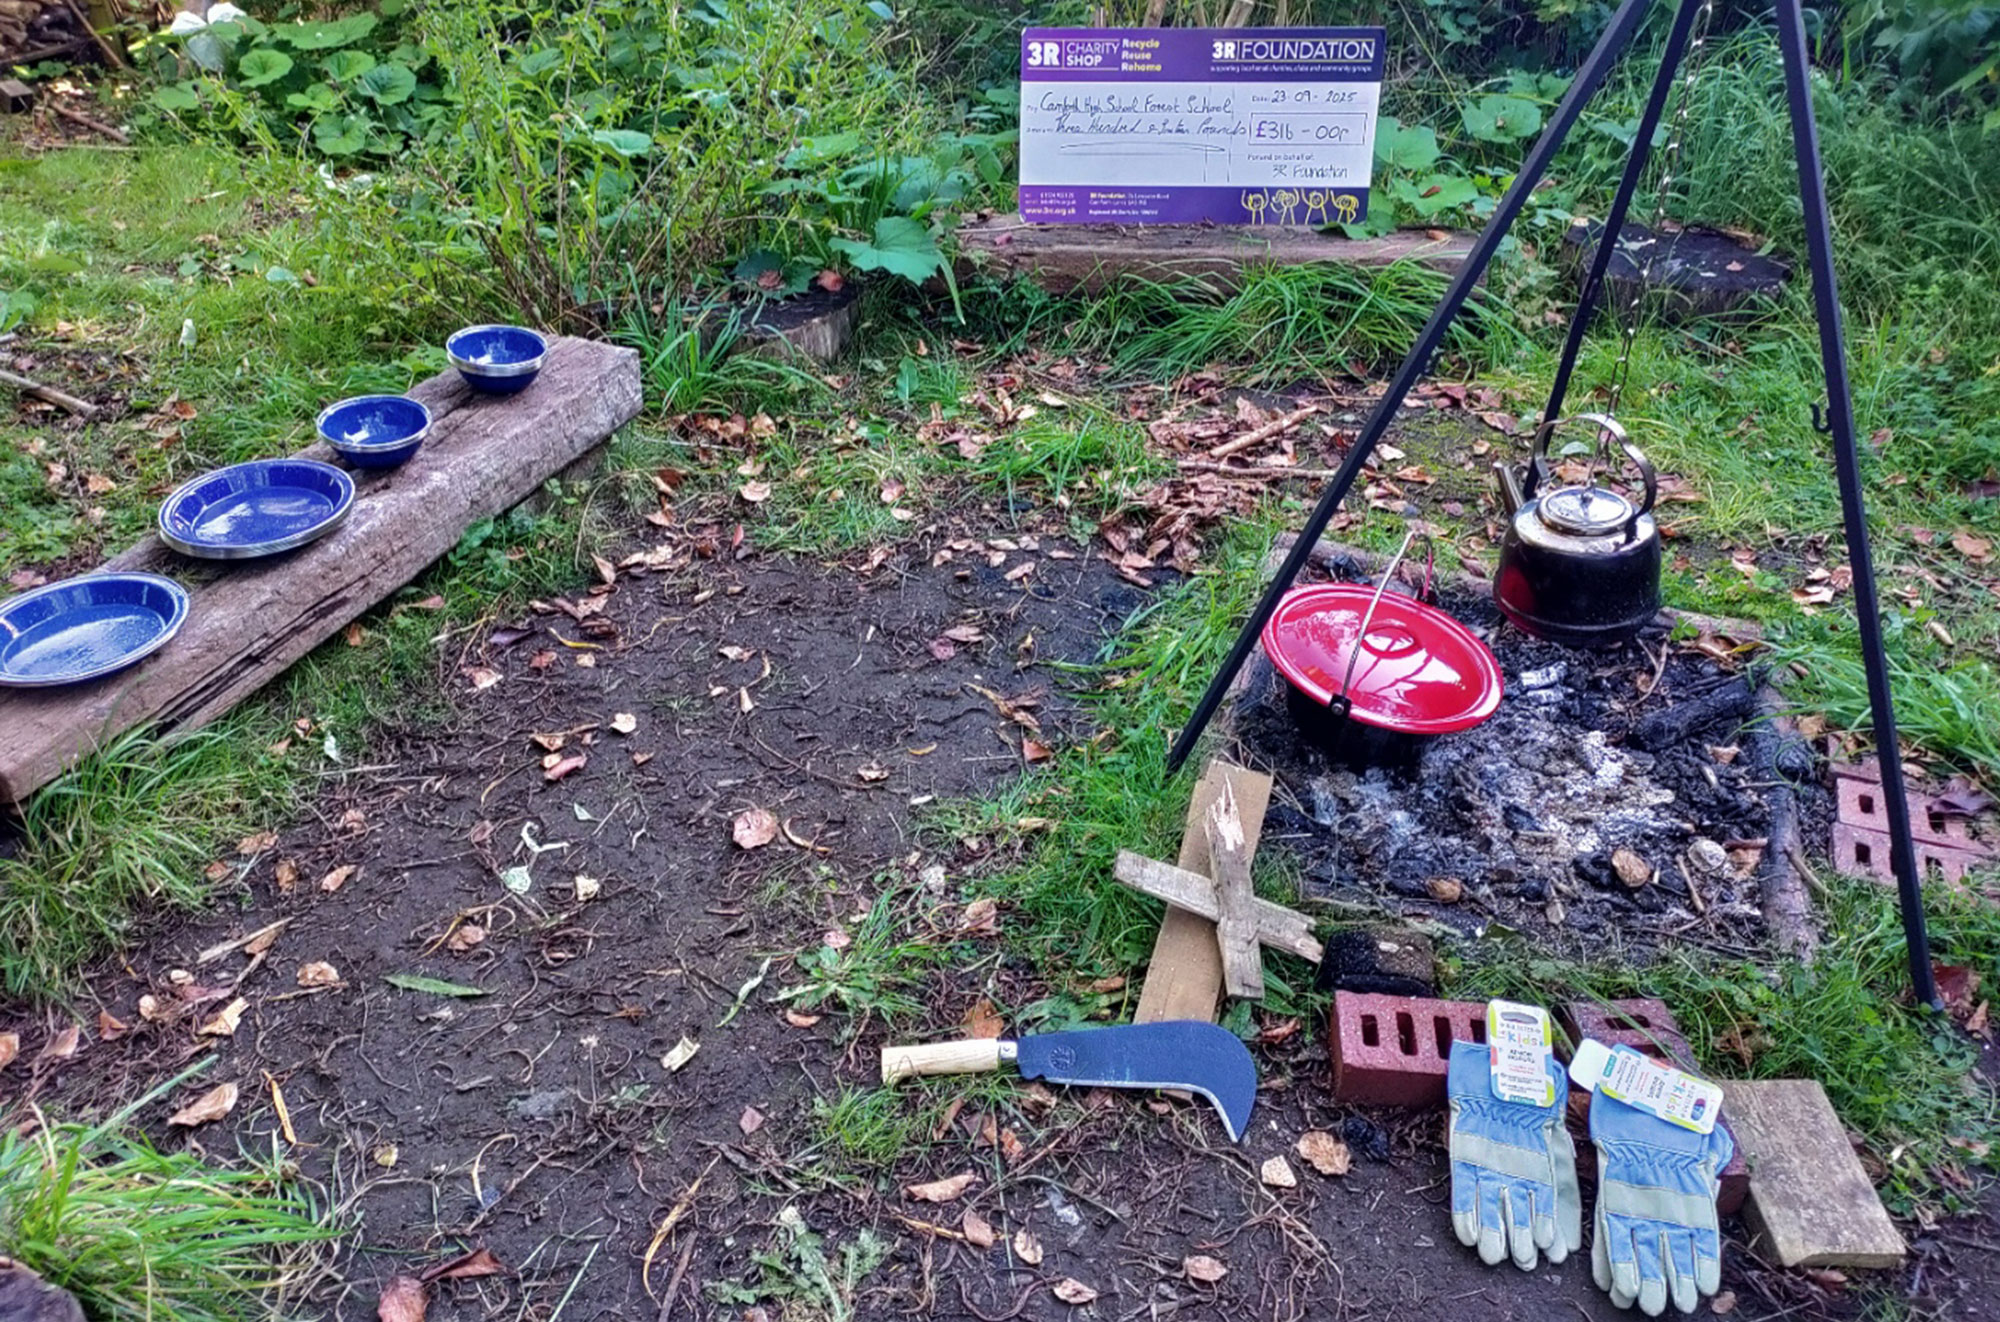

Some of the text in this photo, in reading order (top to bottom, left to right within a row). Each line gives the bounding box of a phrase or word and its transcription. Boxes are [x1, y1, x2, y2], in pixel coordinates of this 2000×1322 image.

[1066, 42, 1120, 54] CHARITY
[1121, 38, 1160, 51] Recycle
[1212, 40, 1375, 59] 3R FOUNDATION
[1027, 42, 1060, 66] 3R
[1121, 50, 1152, 60] Reuse
[1066, 55, 1103, 67] SHOP
[1121, 62, 1162, 72] Rehome
[1144, 93, 1181, 113] Forest
[1187, 94, 1232, 114] School
